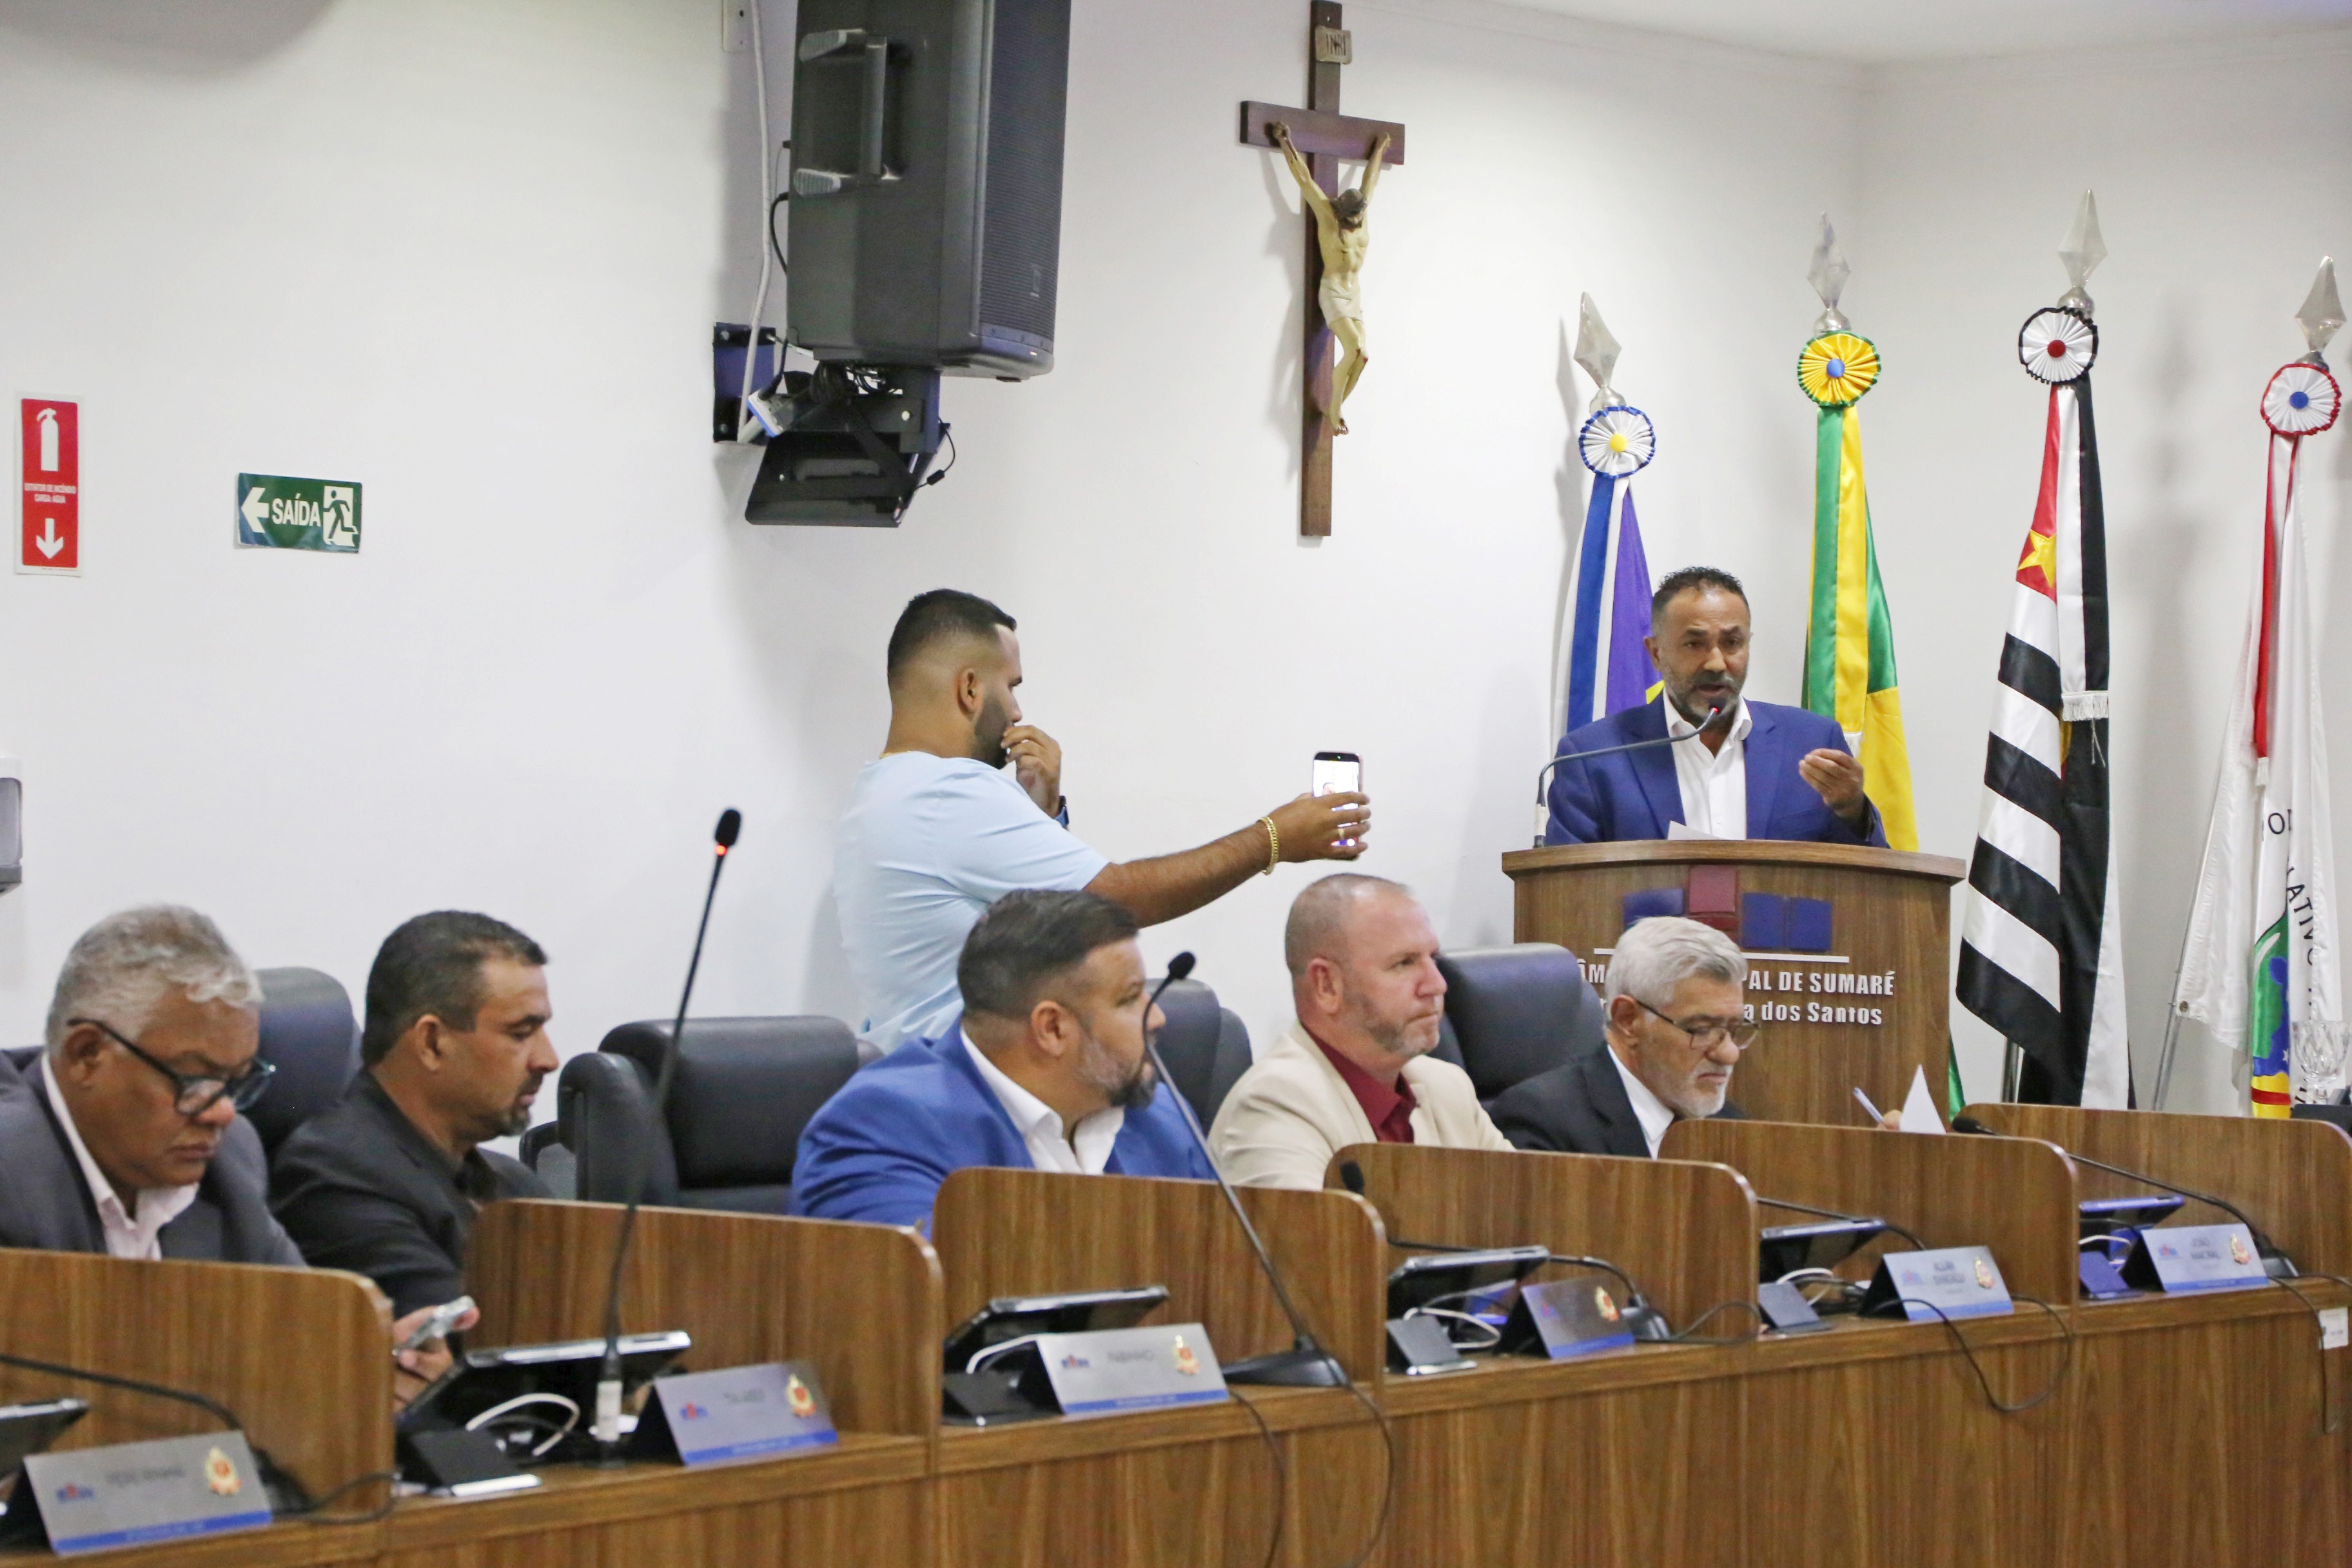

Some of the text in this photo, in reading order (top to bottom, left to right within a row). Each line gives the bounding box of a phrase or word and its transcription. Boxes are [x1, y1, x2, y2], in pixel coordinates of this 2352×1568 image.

[1326, 33, 1346, 56] INRI
[271, 493, 322, 527] SAÍDA
[1778, 971, 1803, 992] DE
[1809, 970, 1896, 996] SUMARÉ
[1761, 1001, 1801, 1022] dos
[1807, 1001, 1883, 1025] Santos
